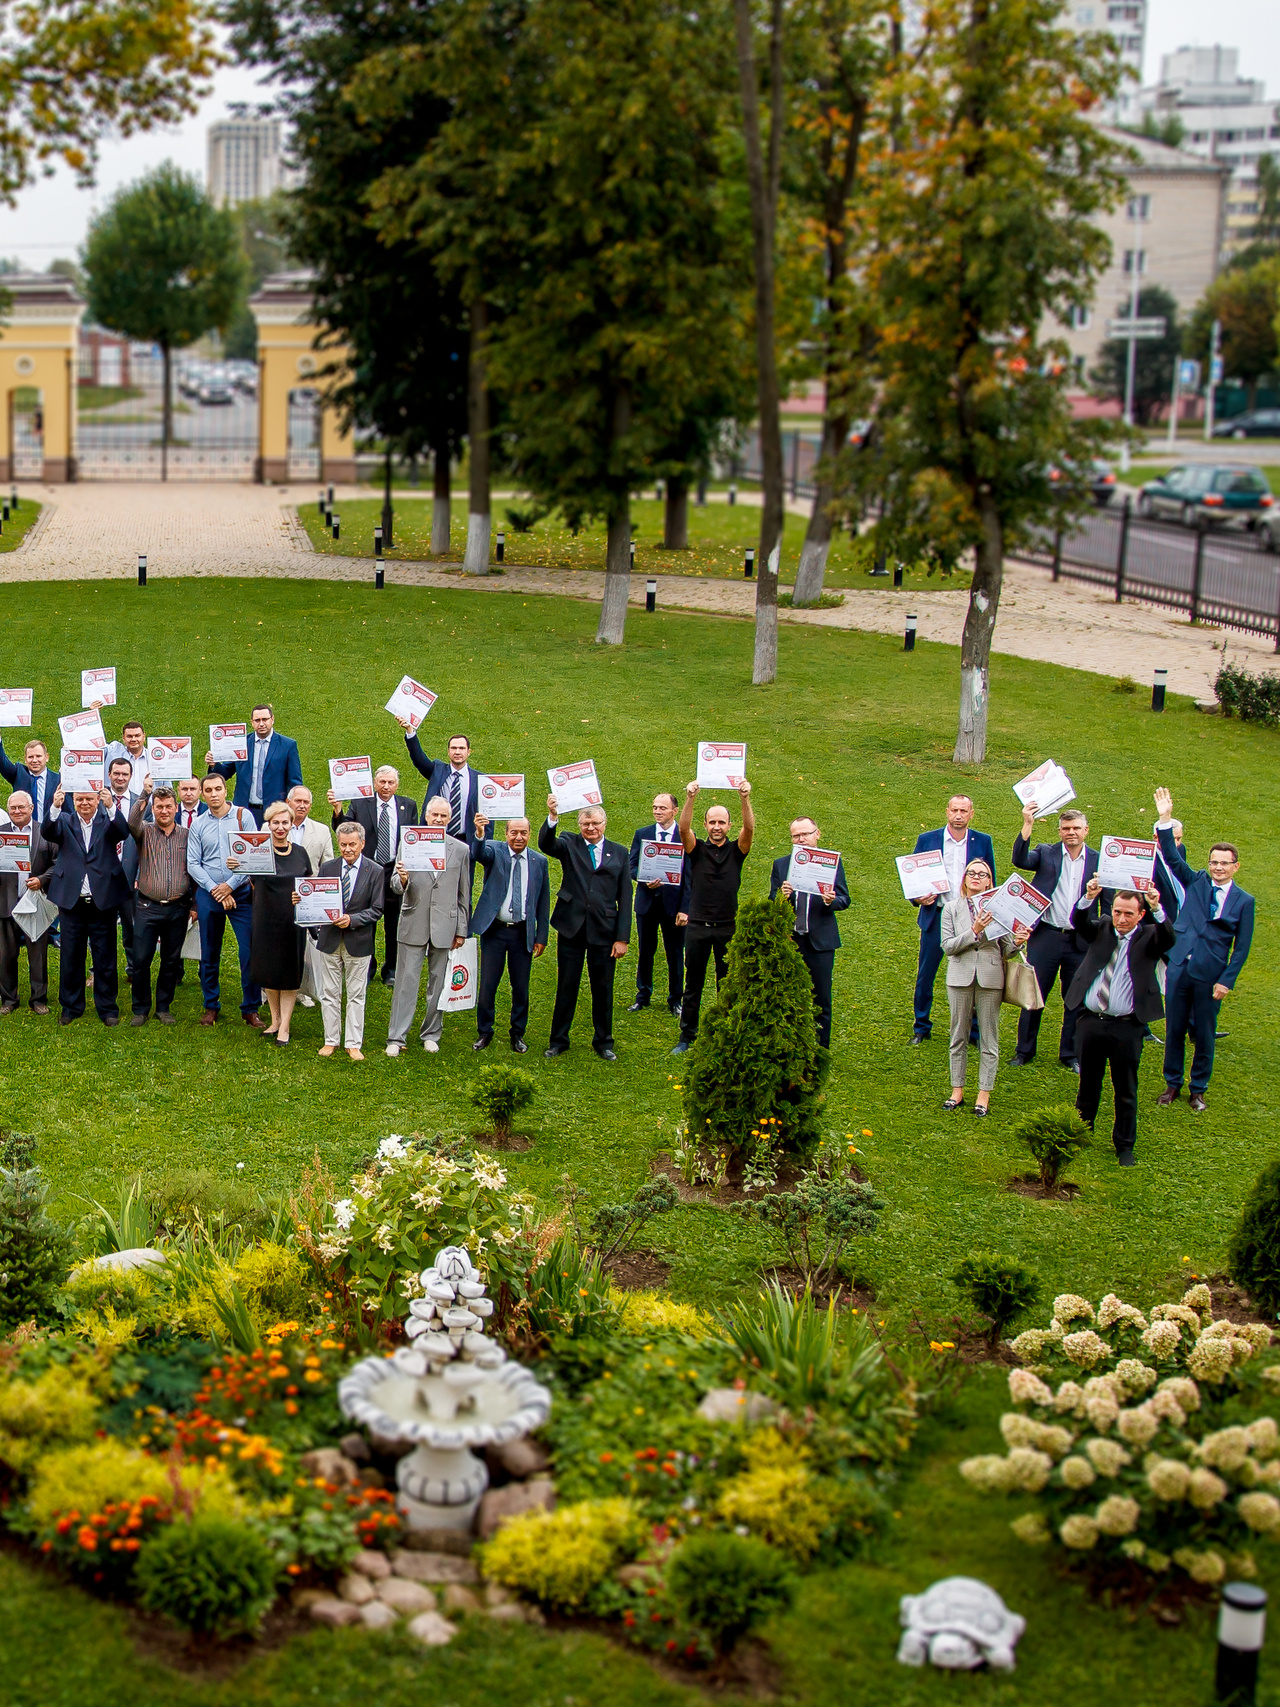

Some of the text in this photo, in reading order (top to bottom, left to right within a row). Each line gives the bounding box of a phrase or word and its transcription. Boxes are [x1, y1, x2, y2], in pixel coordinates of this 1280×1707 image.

[1125, 847, 1151, 855] ДИПЛОМ
[812, 856, 835, 865] ДИПЛОМ
[918, 857, 940, 867] ДИПЛОМ
[1023, 892, 1045, 909] ДИПЛОМ
